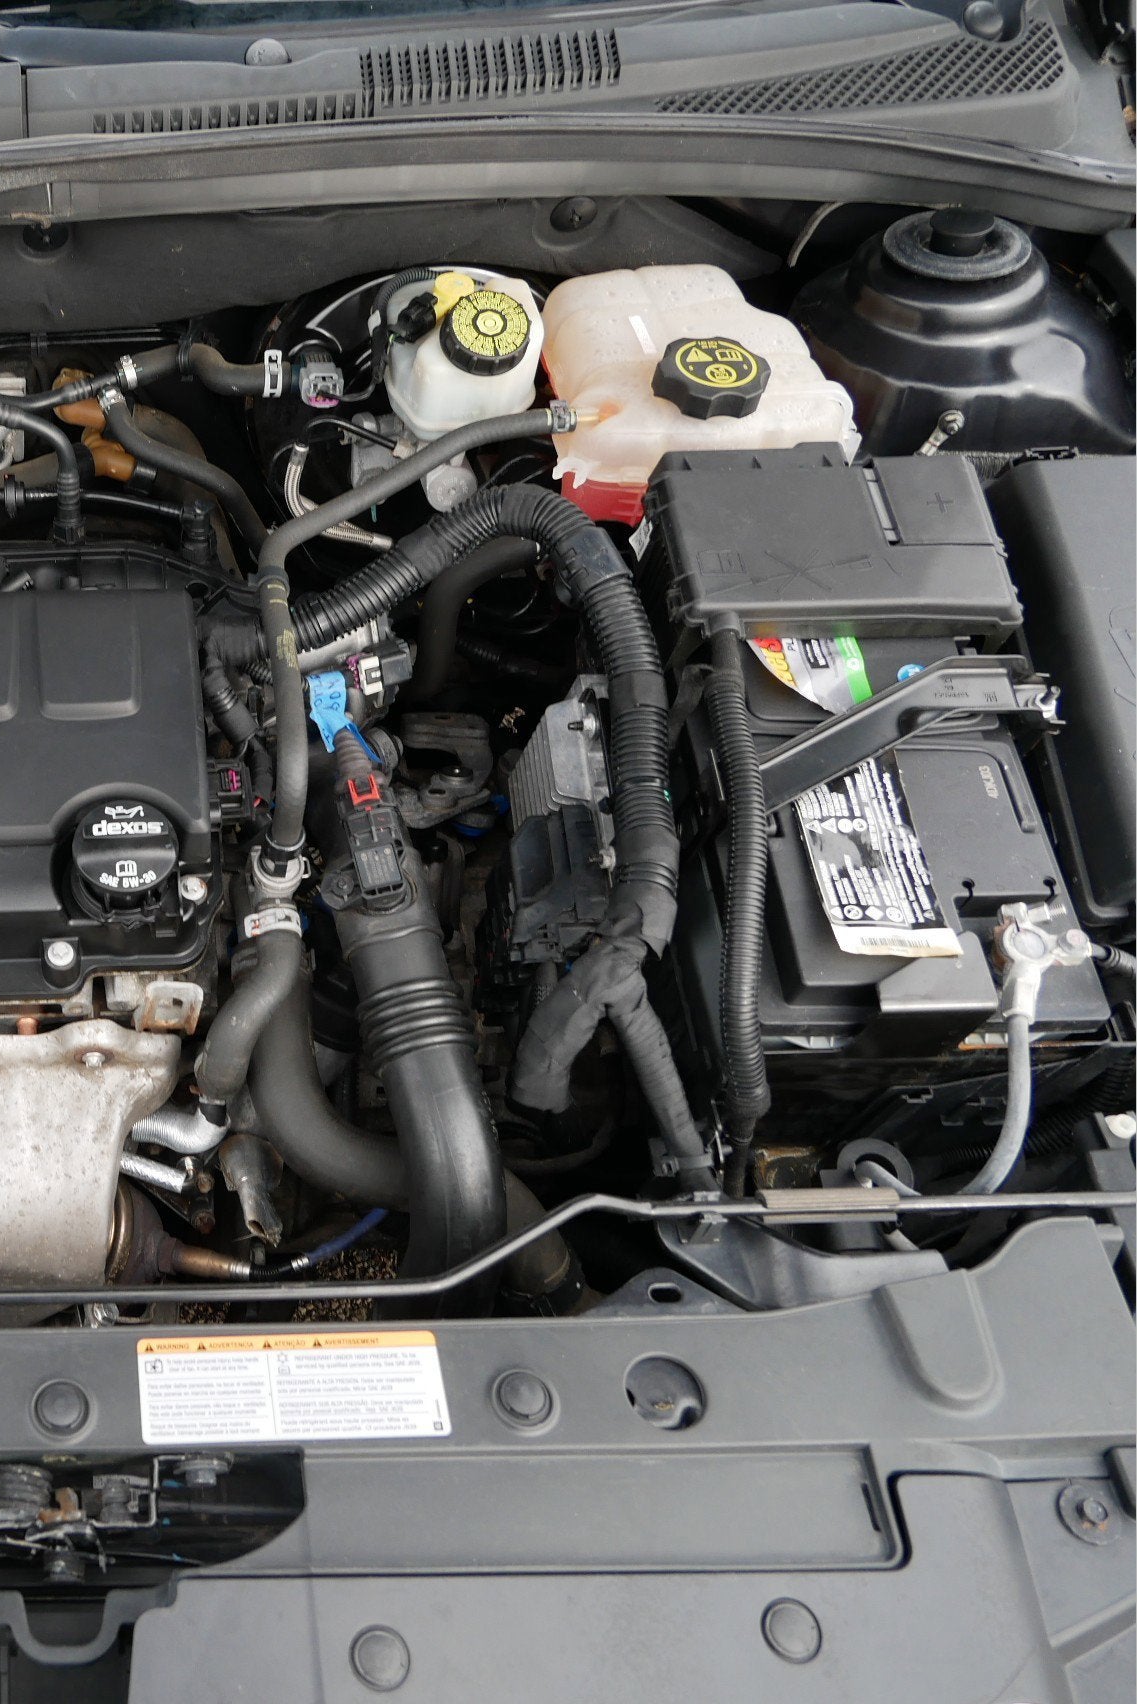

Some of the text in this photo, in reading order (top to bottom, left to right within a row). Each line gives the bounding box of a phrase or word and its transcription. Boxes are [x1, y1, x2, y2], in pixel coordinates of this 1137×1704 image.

[92, 819, 163, 836] dexos
[99, 869, 157, 888] SAE 5W-30
